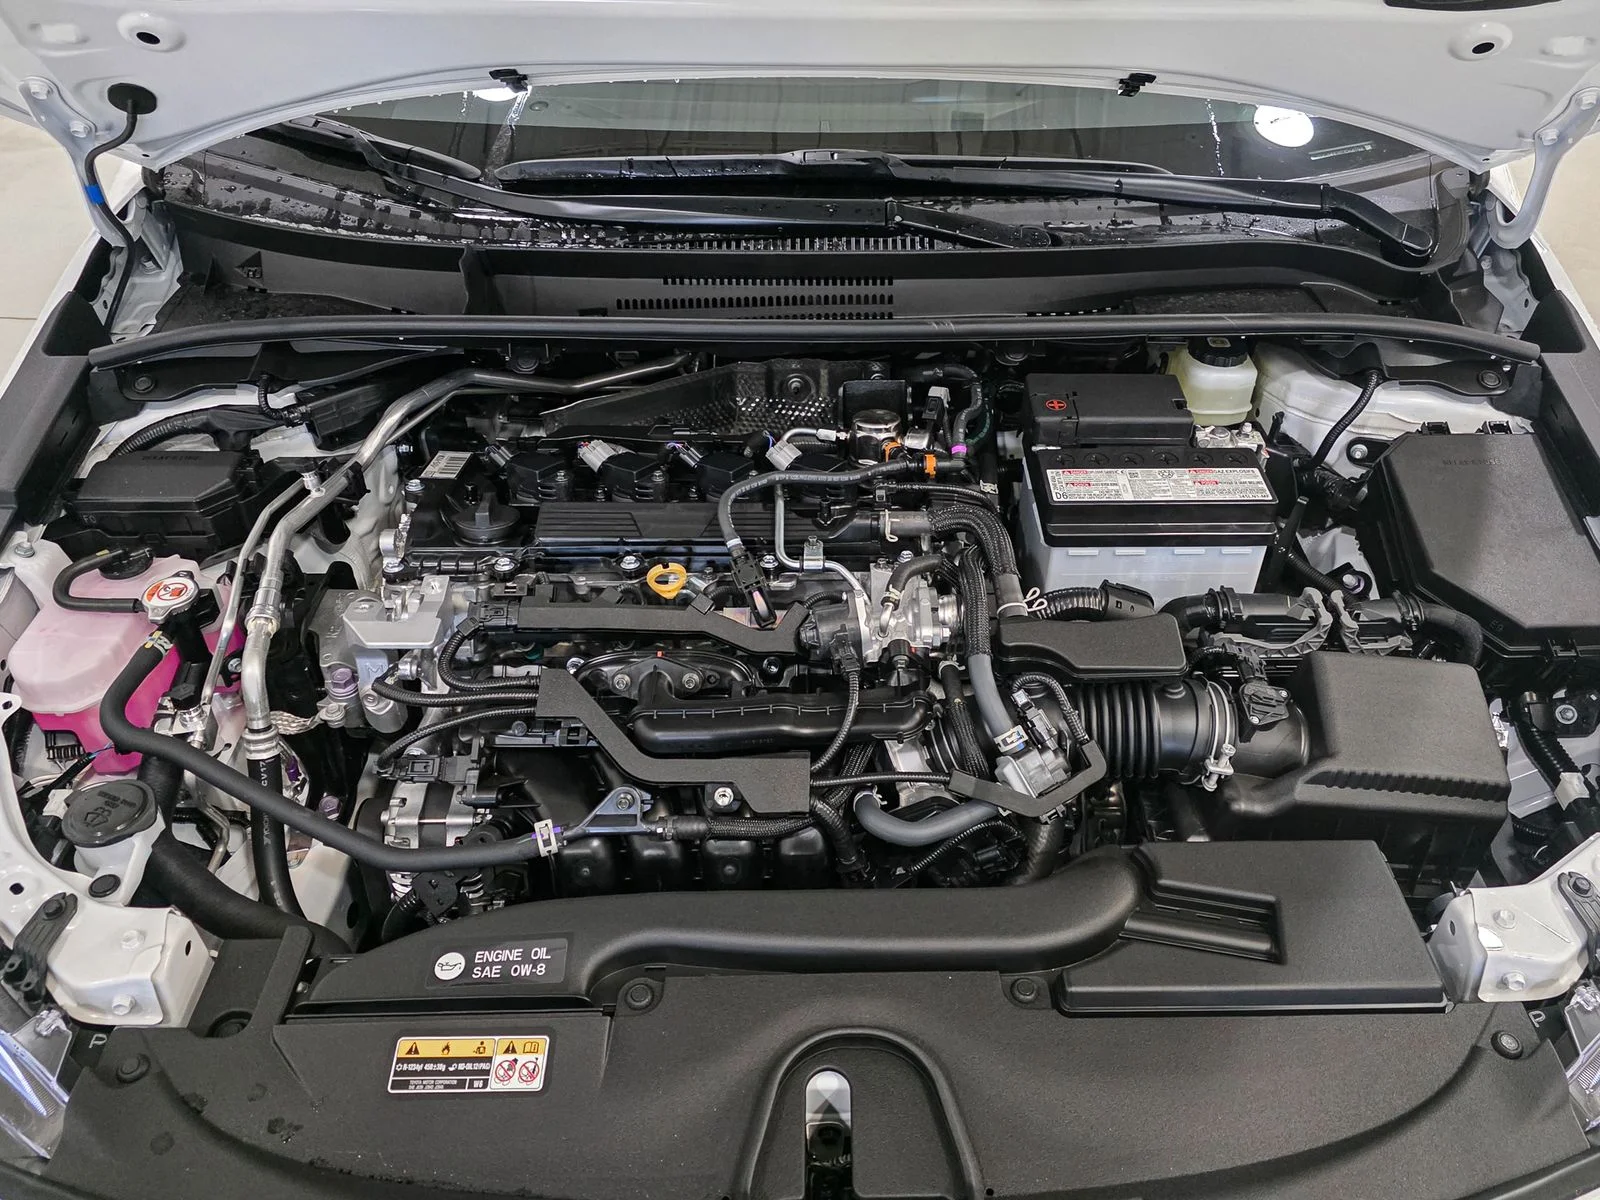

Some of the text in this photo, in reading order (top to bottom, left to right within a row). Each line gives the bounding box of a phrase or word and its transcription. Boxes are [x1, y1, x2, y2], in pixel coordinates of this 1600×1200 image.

[1055, 491, 1069, 500] D6
[475, 947, 551, 963] ENGINE OIL
[472, 963, 546, 979] SAE 0W-8
[88, 1033, 108, 1049] P
